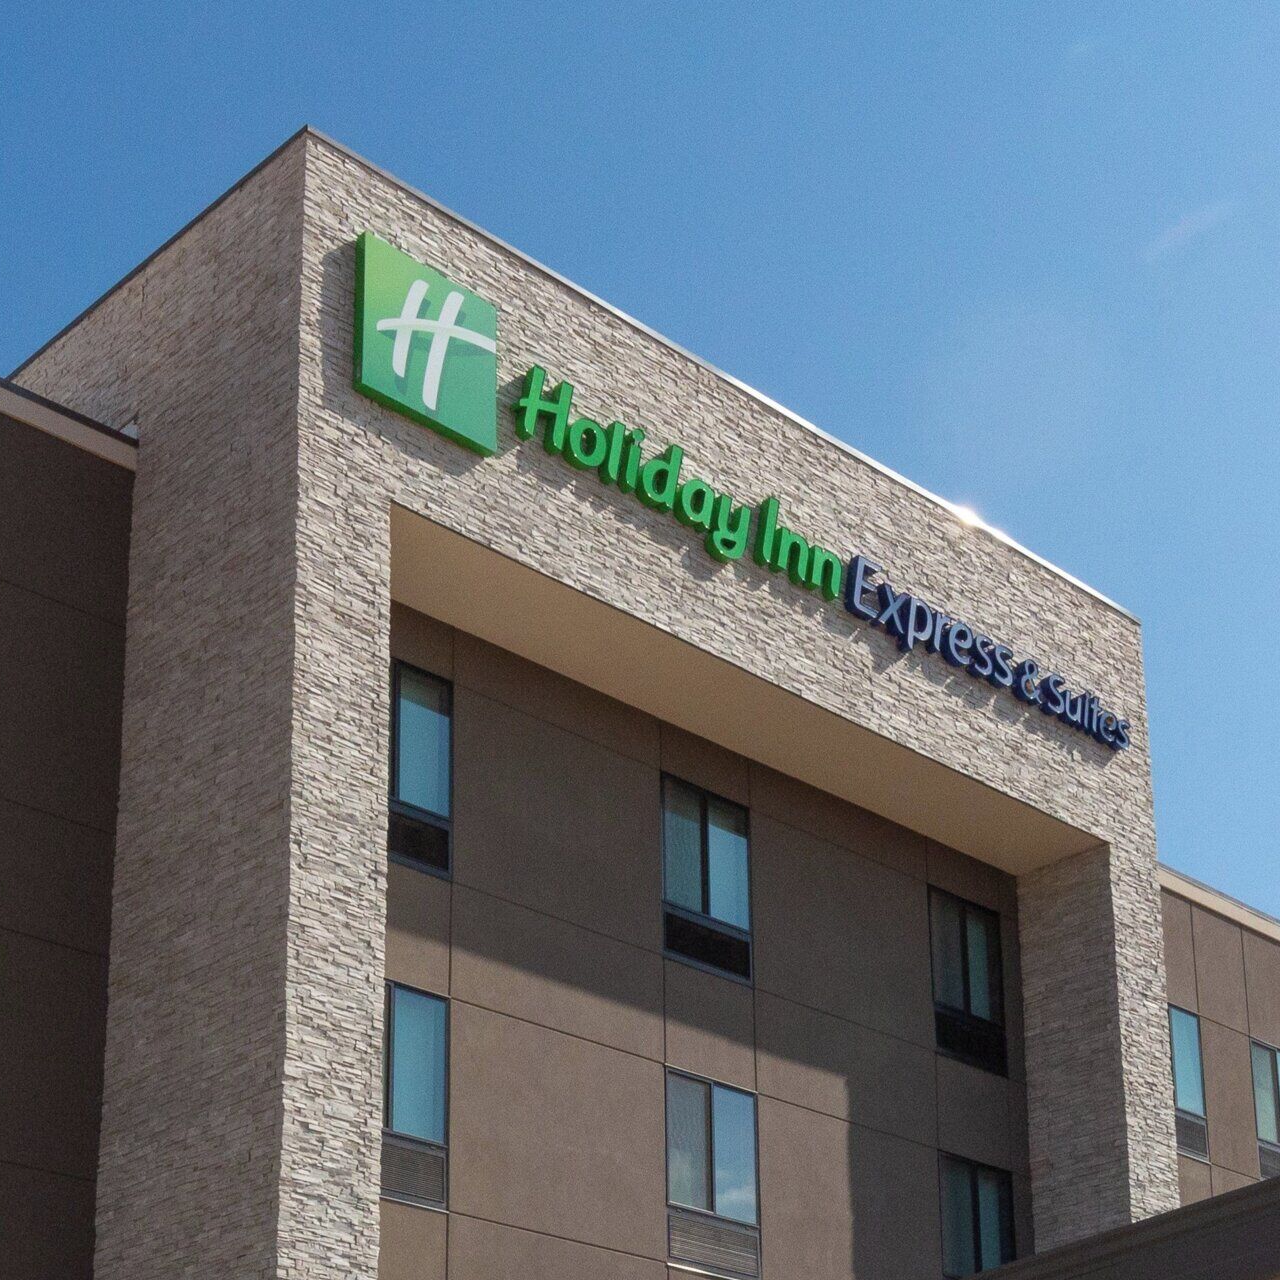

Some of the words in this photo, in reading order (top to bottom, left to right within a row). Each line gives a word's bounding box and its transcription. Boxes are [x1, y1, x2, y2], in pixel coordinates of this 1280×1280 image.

[511, 363, 751, 563] Holiday
[753, 496, 842, 600] Inn
[845, 555, 1013, 688] Express
[1013, 659, 1042, 706] &
[1039, 674, 1130, 751] Suites
